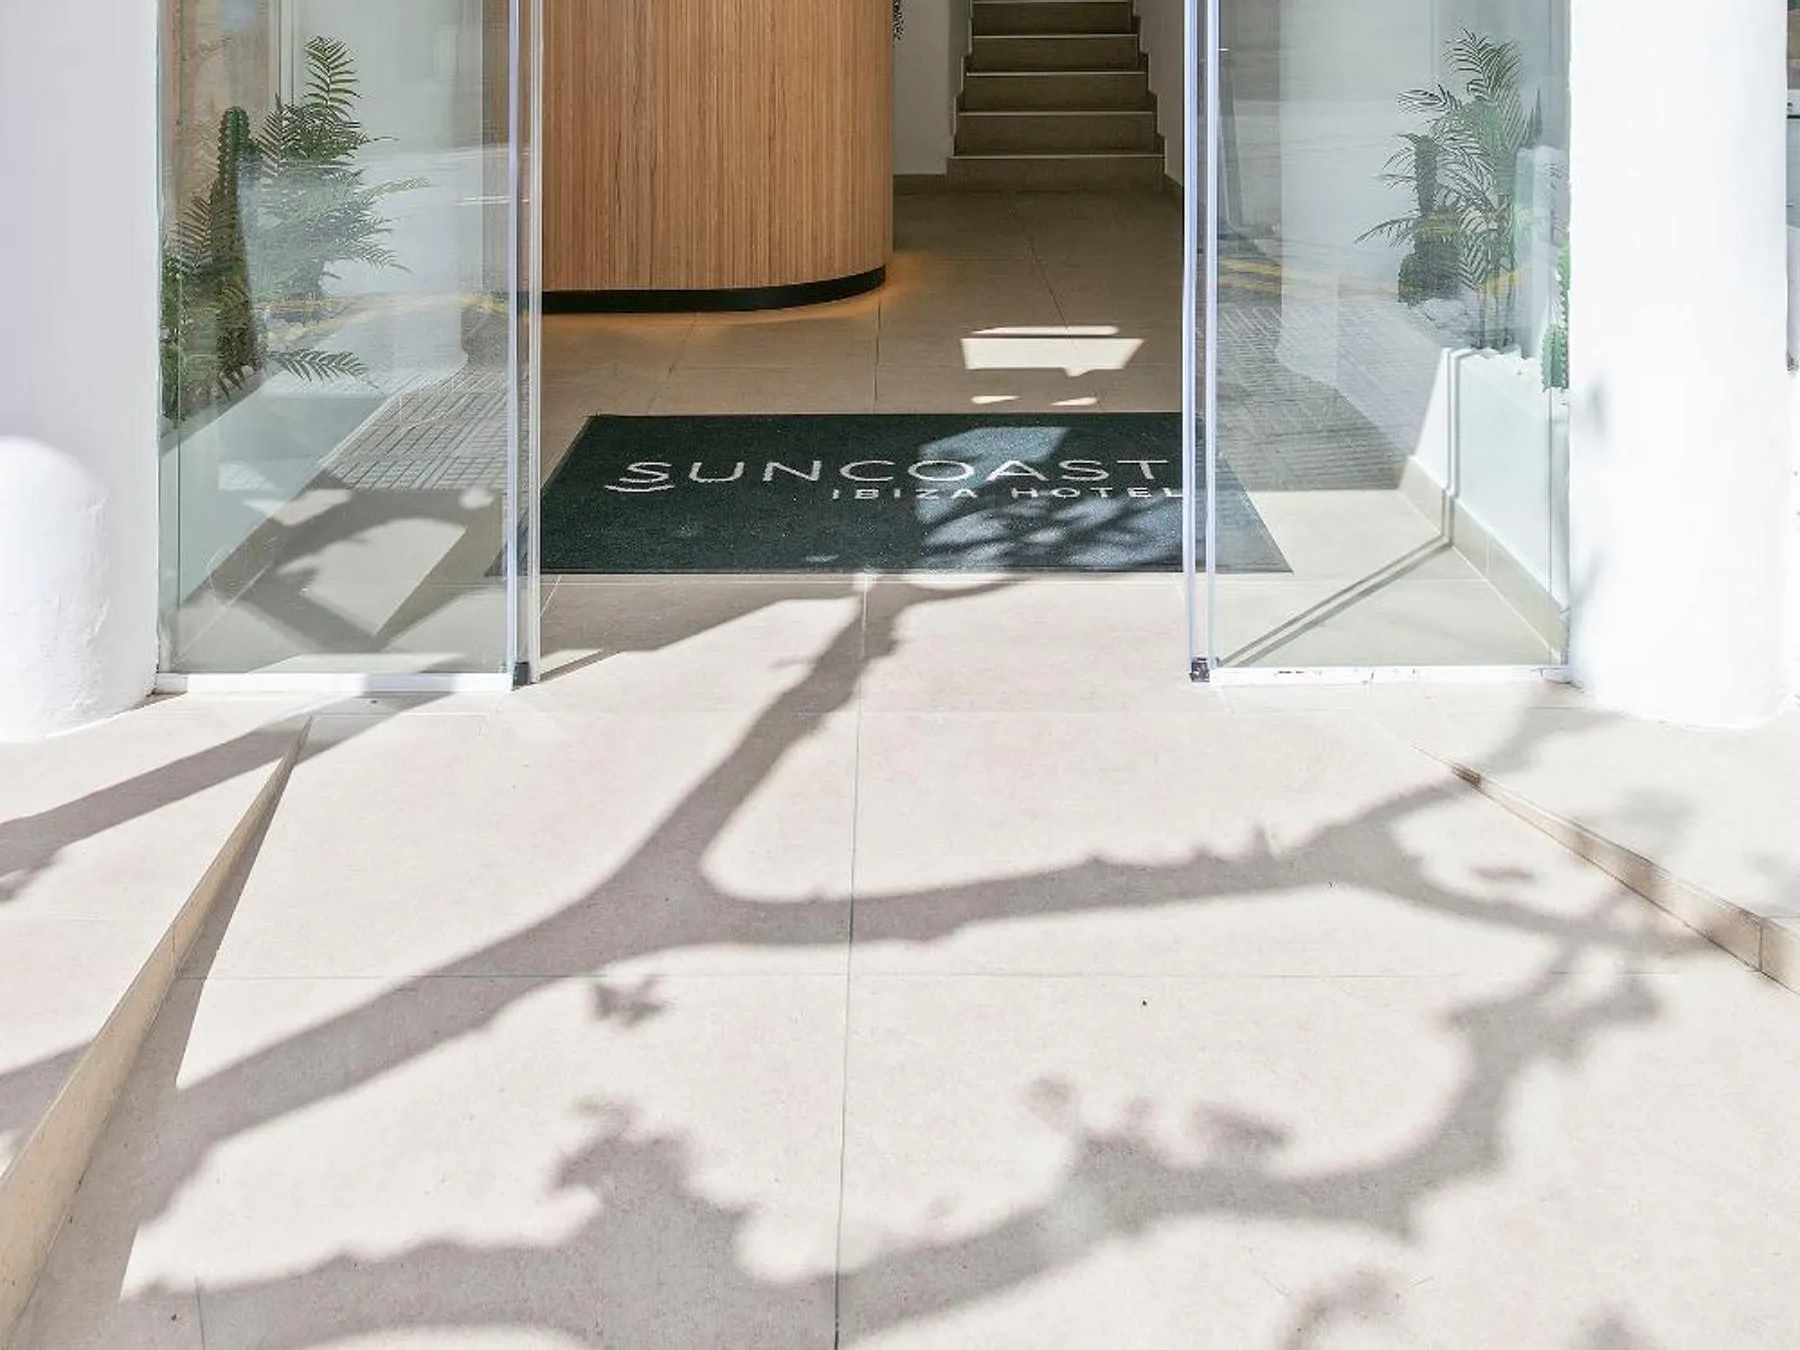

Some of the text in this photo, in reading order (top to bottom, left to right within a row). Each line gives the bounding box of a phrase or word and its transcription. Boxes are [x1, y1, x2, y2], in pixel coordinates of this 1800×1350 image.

[618, 459, 1169, 484] SUNCOAST
[832, 487, 1184, 500] IBIZA HOTEL
